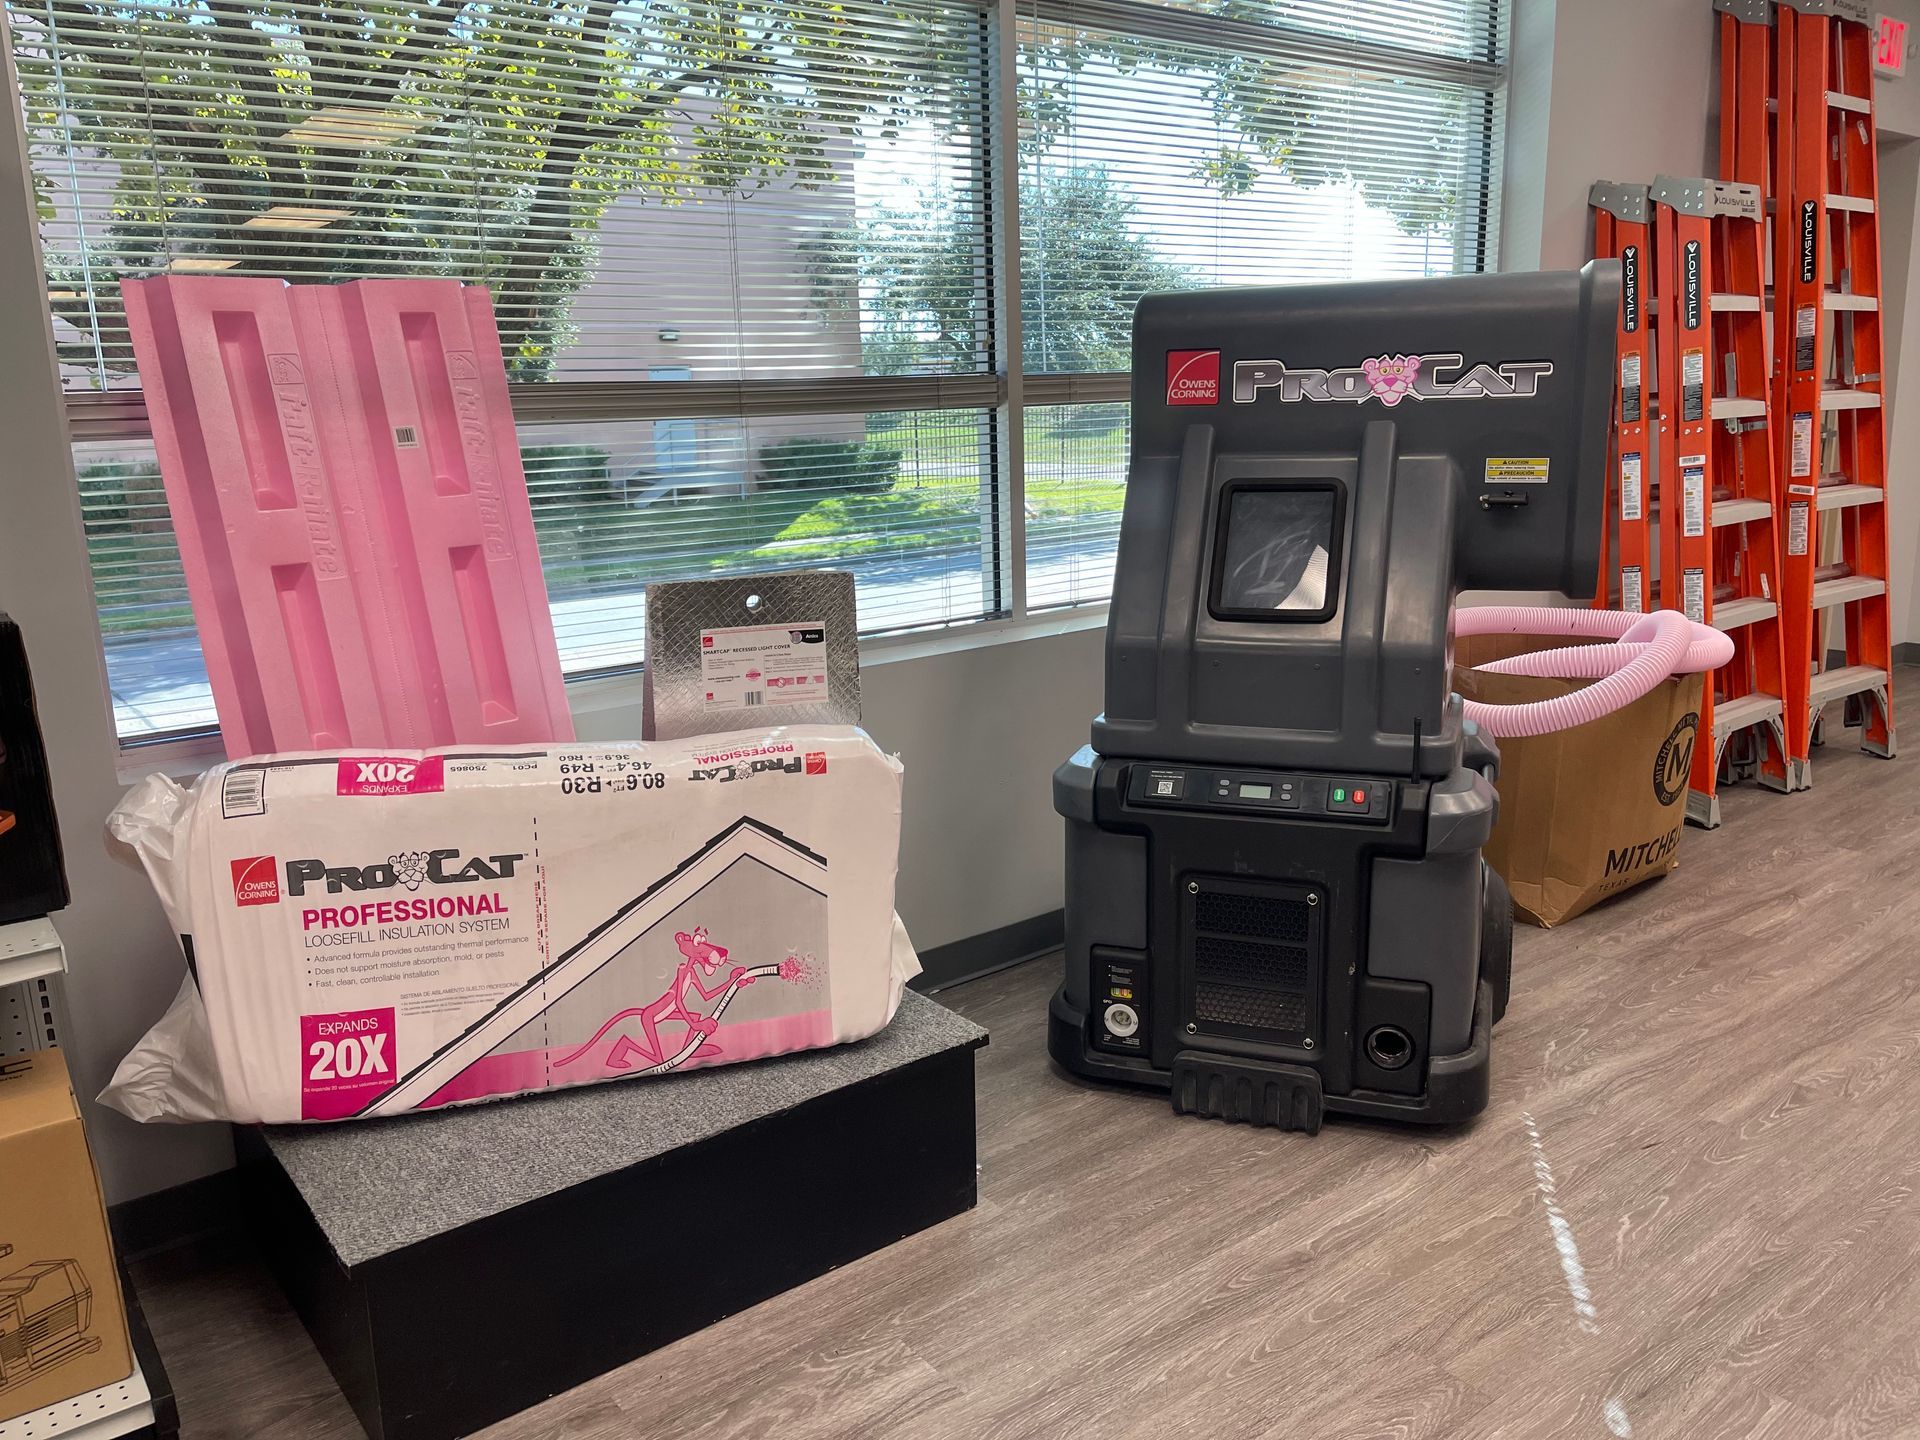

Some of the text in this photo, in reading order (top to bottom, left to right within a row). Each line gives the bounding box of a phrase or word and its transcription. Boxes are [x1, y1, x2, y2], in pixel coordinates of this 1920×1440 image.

[1878, 16, 1905, 69] EXIT
[1718, 197, 1756, 207] LOUISVILLE
[1804, 212, 1813, 282] LOUISVILLE
[1626, 258, 1635, 331] LOUISVILLE
[1688, 253, 1697, 328] LOUISVILLE
[1171, 389, 1216, 399] CORNING
[1179, 379, 1216, 389] OWENS
[693, 744, 794, 765] PROFESSIONAL
[1665, 736, 1694, 783] M
[356, 762, 416, 783] 20X
[560, 761, 652, 774] 46.4 R49
[362, 784, 407, 793] EXPANDS
[561, 776, 602, 794] R30
[626, 772, 665, 790] 80.6
[286, 849, 524, 897] PRO CAT
[238, 889, 277, 901] CORNING
[244, 880, 276, 891] OWENS
[1599, 878, 1629, 892] TEXAS
[302, 893, 509, 931] PROFESSIONAL
[304, 917, 510, 948] LOOSEFILL INSULATION SYSTEM
[314, 936, 529, 963] Advanced formula provides outstanding thermal performance
[315, 966, 334, 976] Does
[336, 965, 348, 973] not
[350, 963, 379, 974] support
[380, 959, 411, 970] moisture
[413, 955, 452, 968] absorption,
[454, 953, 474, 962] mold,
[485, 950, 505, 960] pests
[316, 969, 440, 988] Fast, clean, controllable installation
[318, 1017, 379, 1036] EXPANDS
[309, 1033, 389, 1080] 20X
